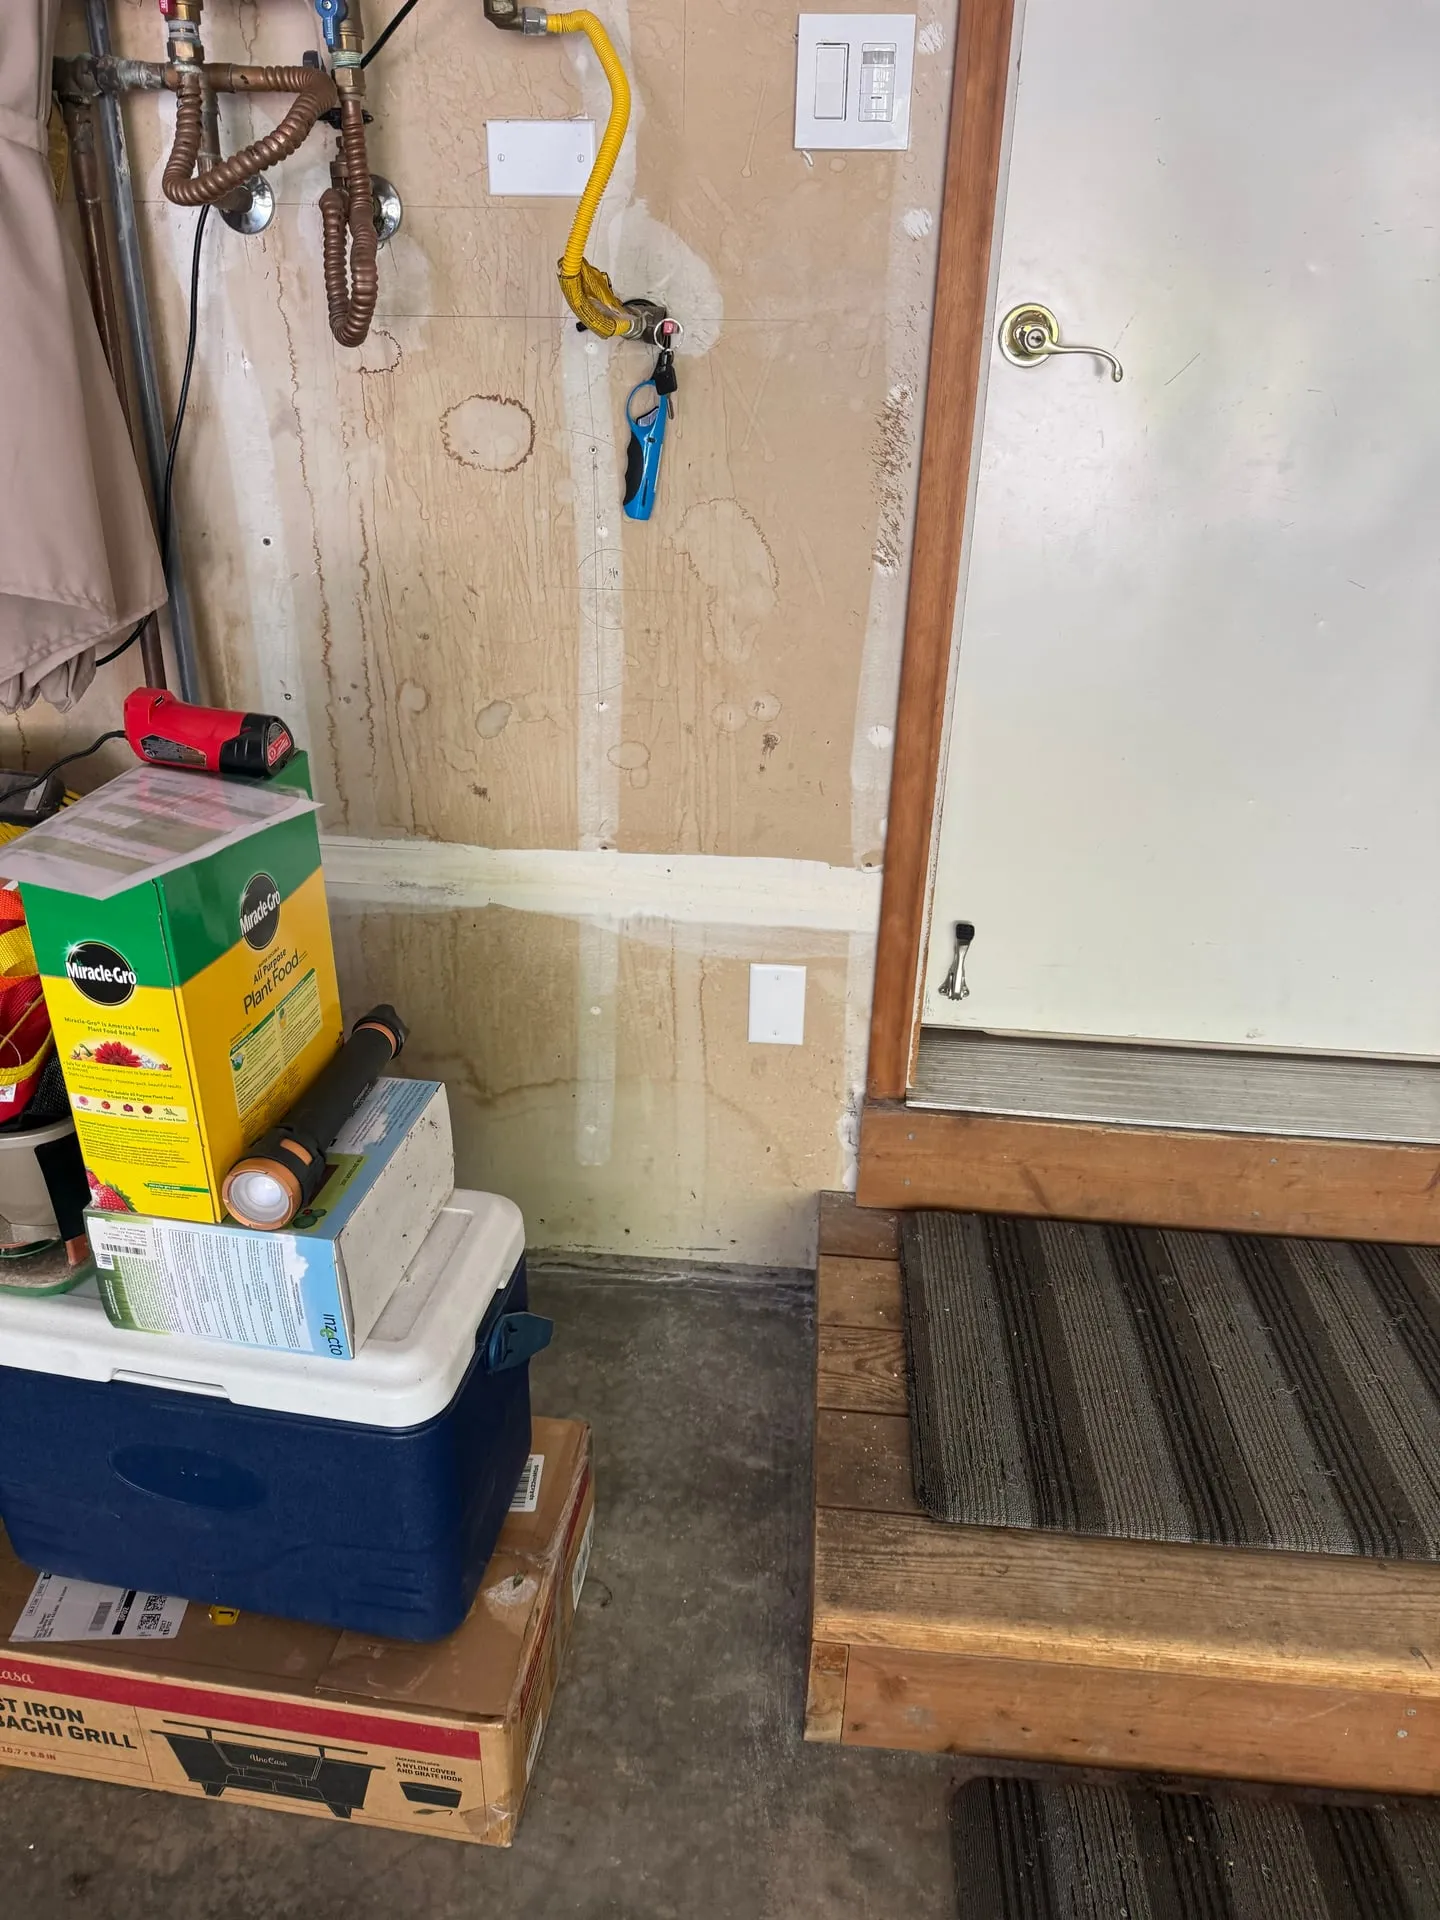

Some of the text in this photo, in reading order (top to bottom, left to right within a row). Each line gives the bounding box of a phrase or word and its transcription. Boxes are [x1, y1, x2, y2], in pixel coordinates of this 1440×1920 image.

[240, 890, 281, 936] Miracle-Gro
[65, 961, 137, 985] Miracle-Gro
[253, 964, 263, 985] All
[263, 948, 287, 975] Purpose
[243, 978, 273, 1015] Plant
[272, 948, 300, 988] Food
[0, 1670, 35, 1684] asa
[23, 1701, 85, 1724] IRON
[67, 1725, 138, 1750] GRILL
[403, 1763, 429, 1772] NYLON
[430, 1767, 456, 1776] COVER
[415, 1770, 439, 1779] GRATE
[441, 1775, 463, 1783] HOOK
